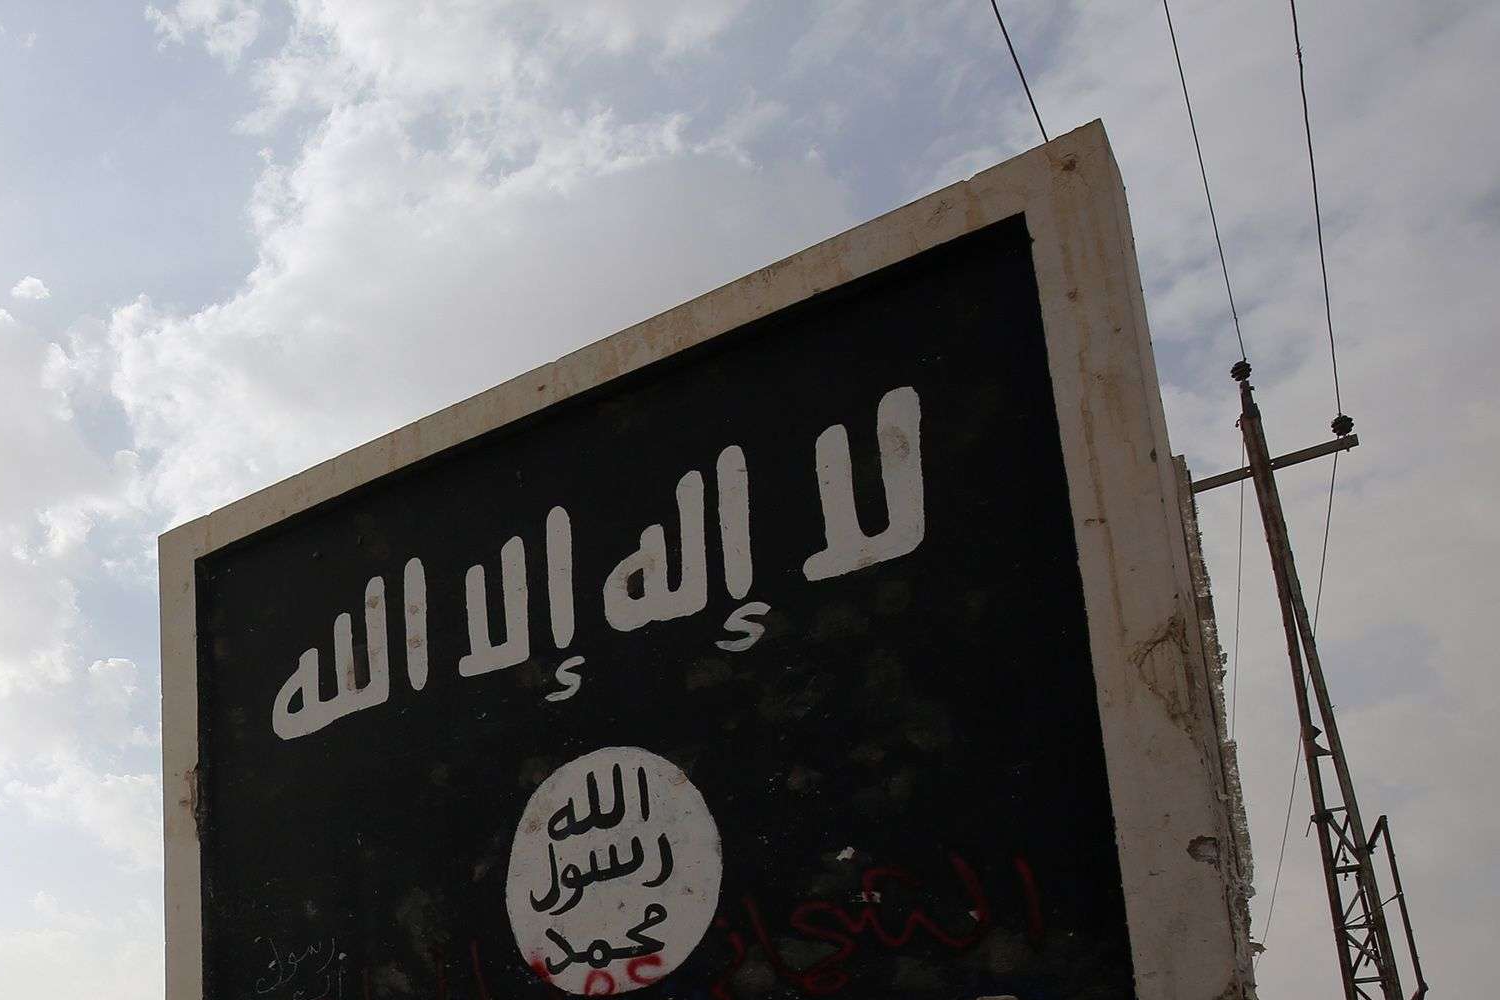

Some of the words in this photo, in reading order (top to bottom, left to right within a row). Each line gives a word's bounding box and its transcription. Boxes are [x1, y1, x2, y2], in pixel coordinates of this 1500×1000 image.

[603, 444, 771, 652] إله
[803, 386, 926, 582] لا
[272, 556, 428, 741] الله
[458, 505, 585, 702] إلا
[530, 832, 675, 915] رسول
[546, 763, 650, 843] الله
[544, 902, 668, 975] محمد
